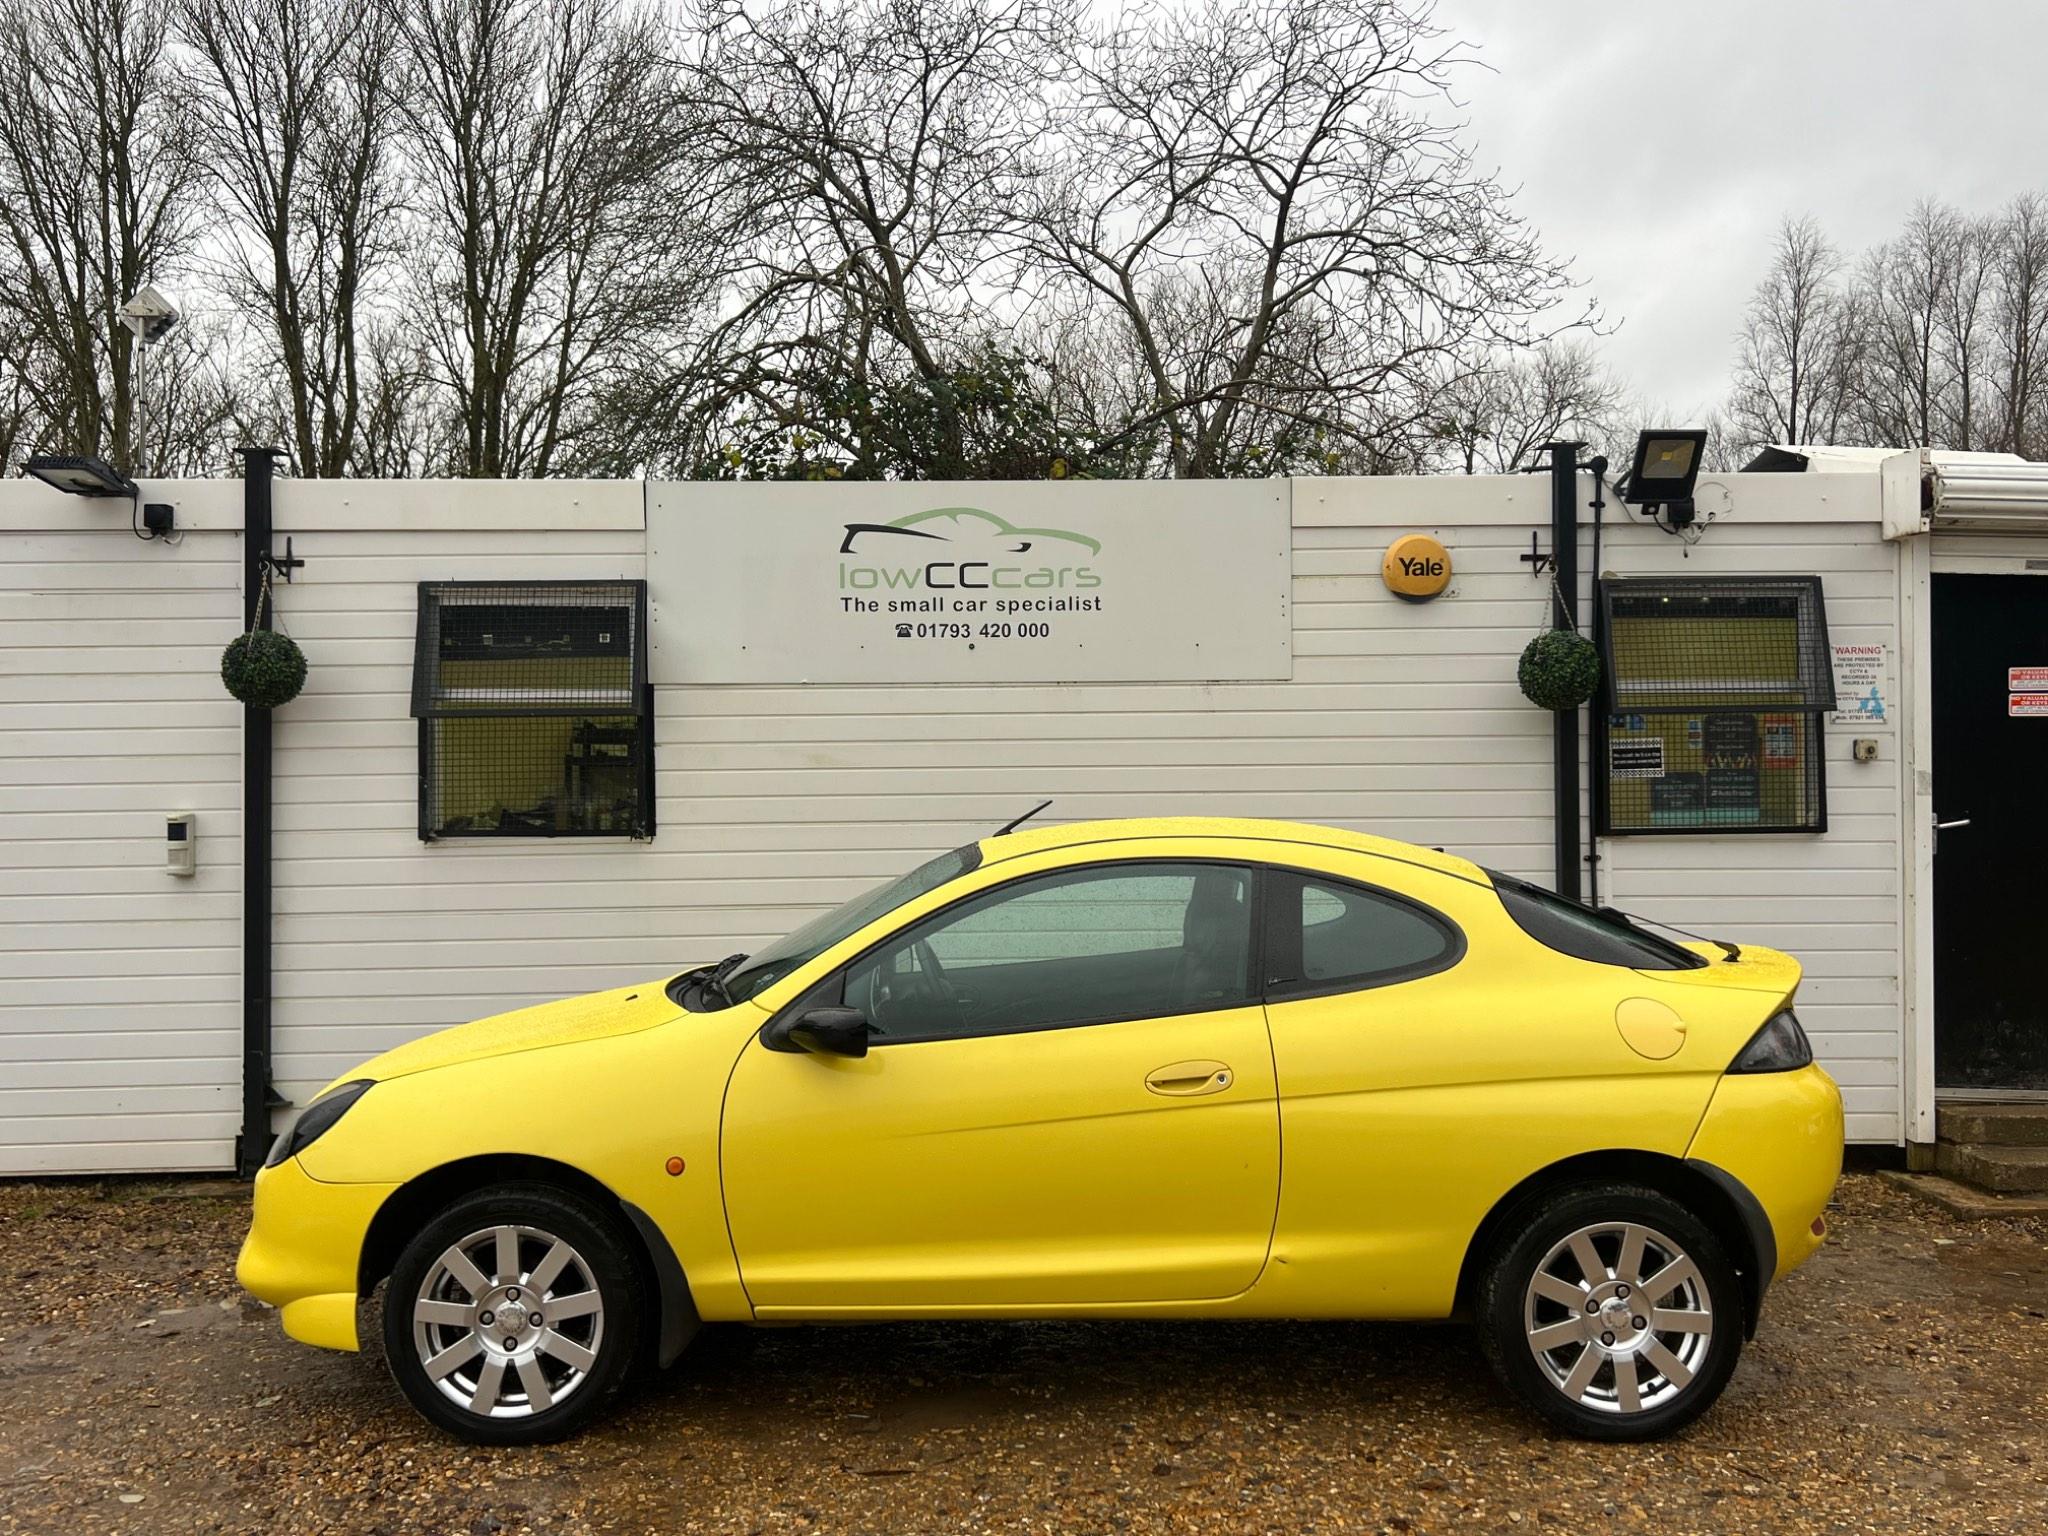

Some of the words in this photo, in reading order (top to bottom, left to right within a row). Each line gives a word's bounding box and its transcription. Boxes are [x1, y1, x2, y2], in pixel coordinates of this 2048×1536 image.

[1398, 557, 1444, 577] Yale
[841, 597, 879, 612] The
[888, 597, 944, 612] small
[953, 600, 988, 612] car
[996, 596, 1102, 615] specialist
[917, 623, 971, 638] 01793
[979, 623, 1012, 638] 420
[1018, 623, 1050, 638] 000
[1835, 646, 1882, 655] WARNING
